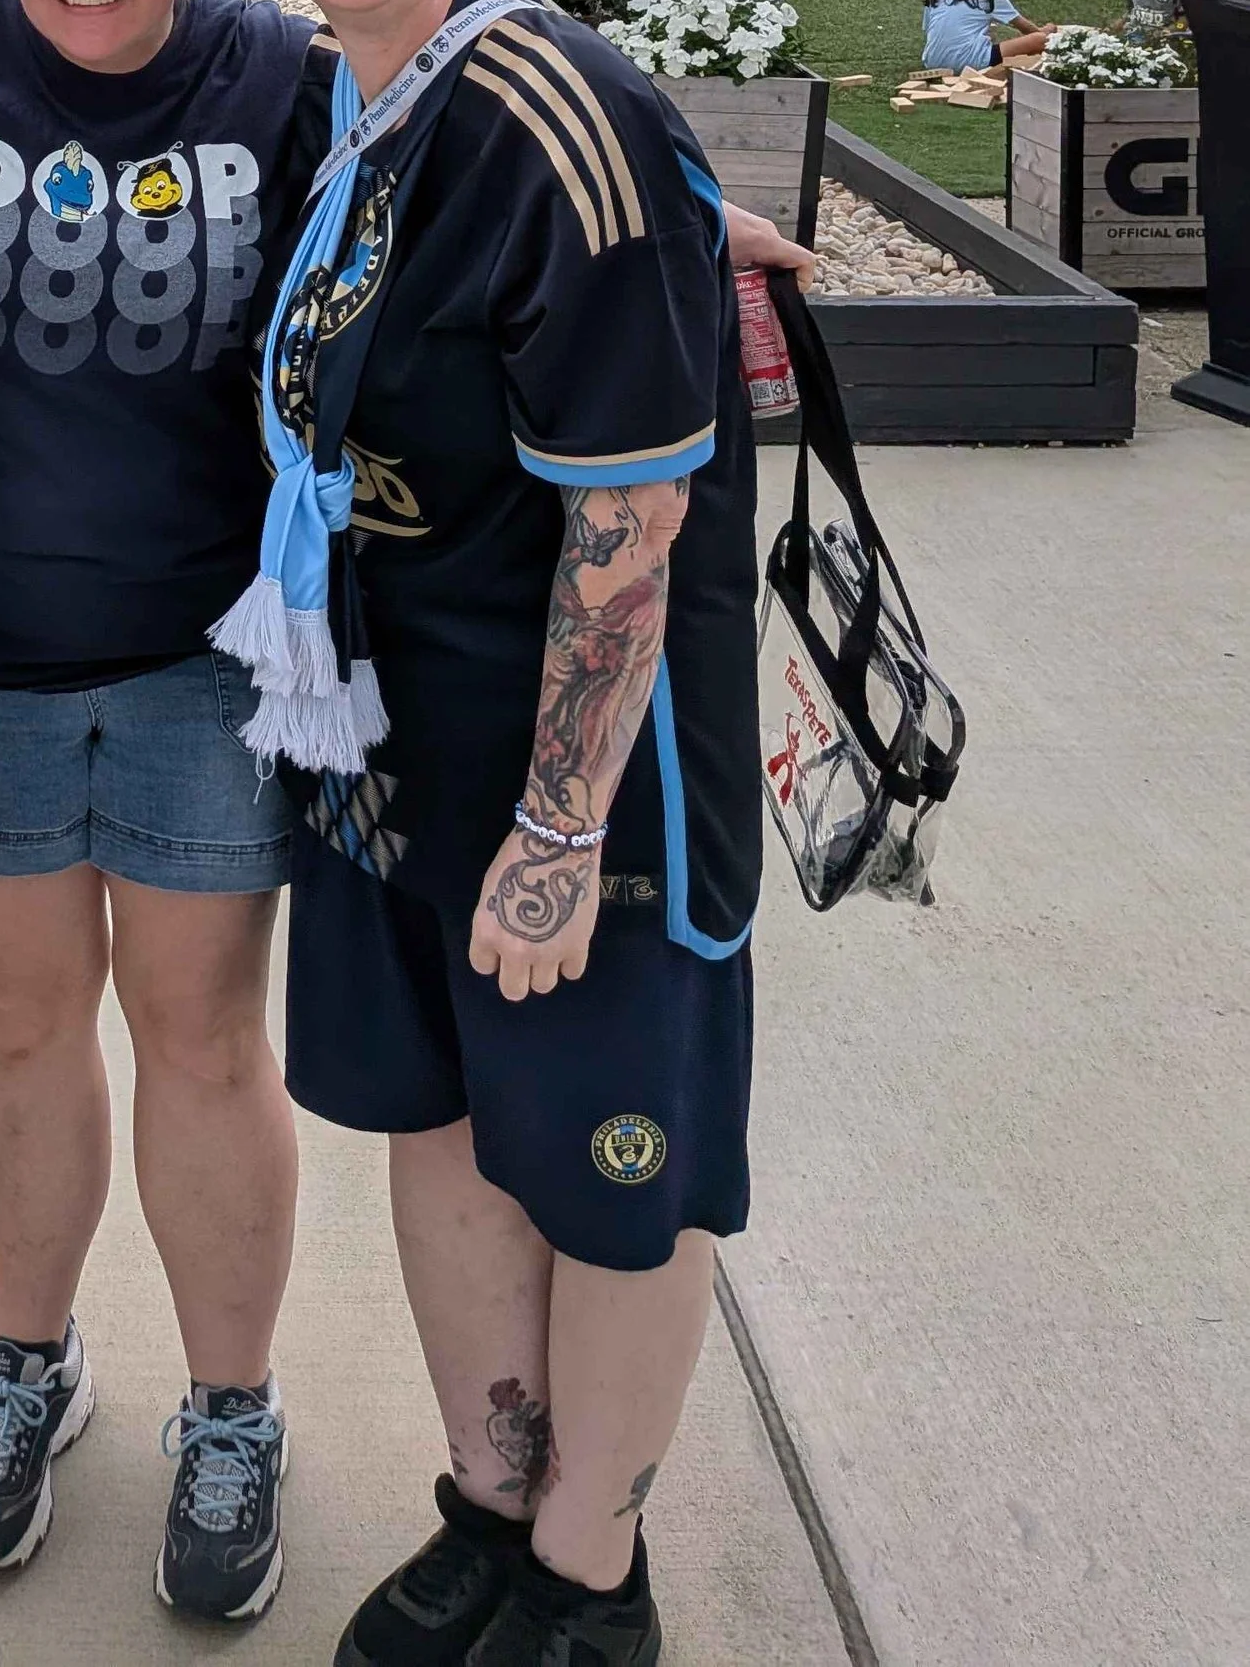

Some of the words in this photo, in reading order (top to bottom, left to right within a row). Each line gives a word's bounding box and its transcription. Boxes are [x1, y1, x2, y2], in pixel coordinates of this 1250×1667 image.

[1104, 137, 1204, 217] G
[1107, 228, 1171, 239] OFFICIAL
[784, 654, 811, 708] TEXAS
[802, 704, 832, 747] PETE
[595, 1117, 662, 1148] PHILADELPHIA
[614, 1133, 643, 1144] UNION
